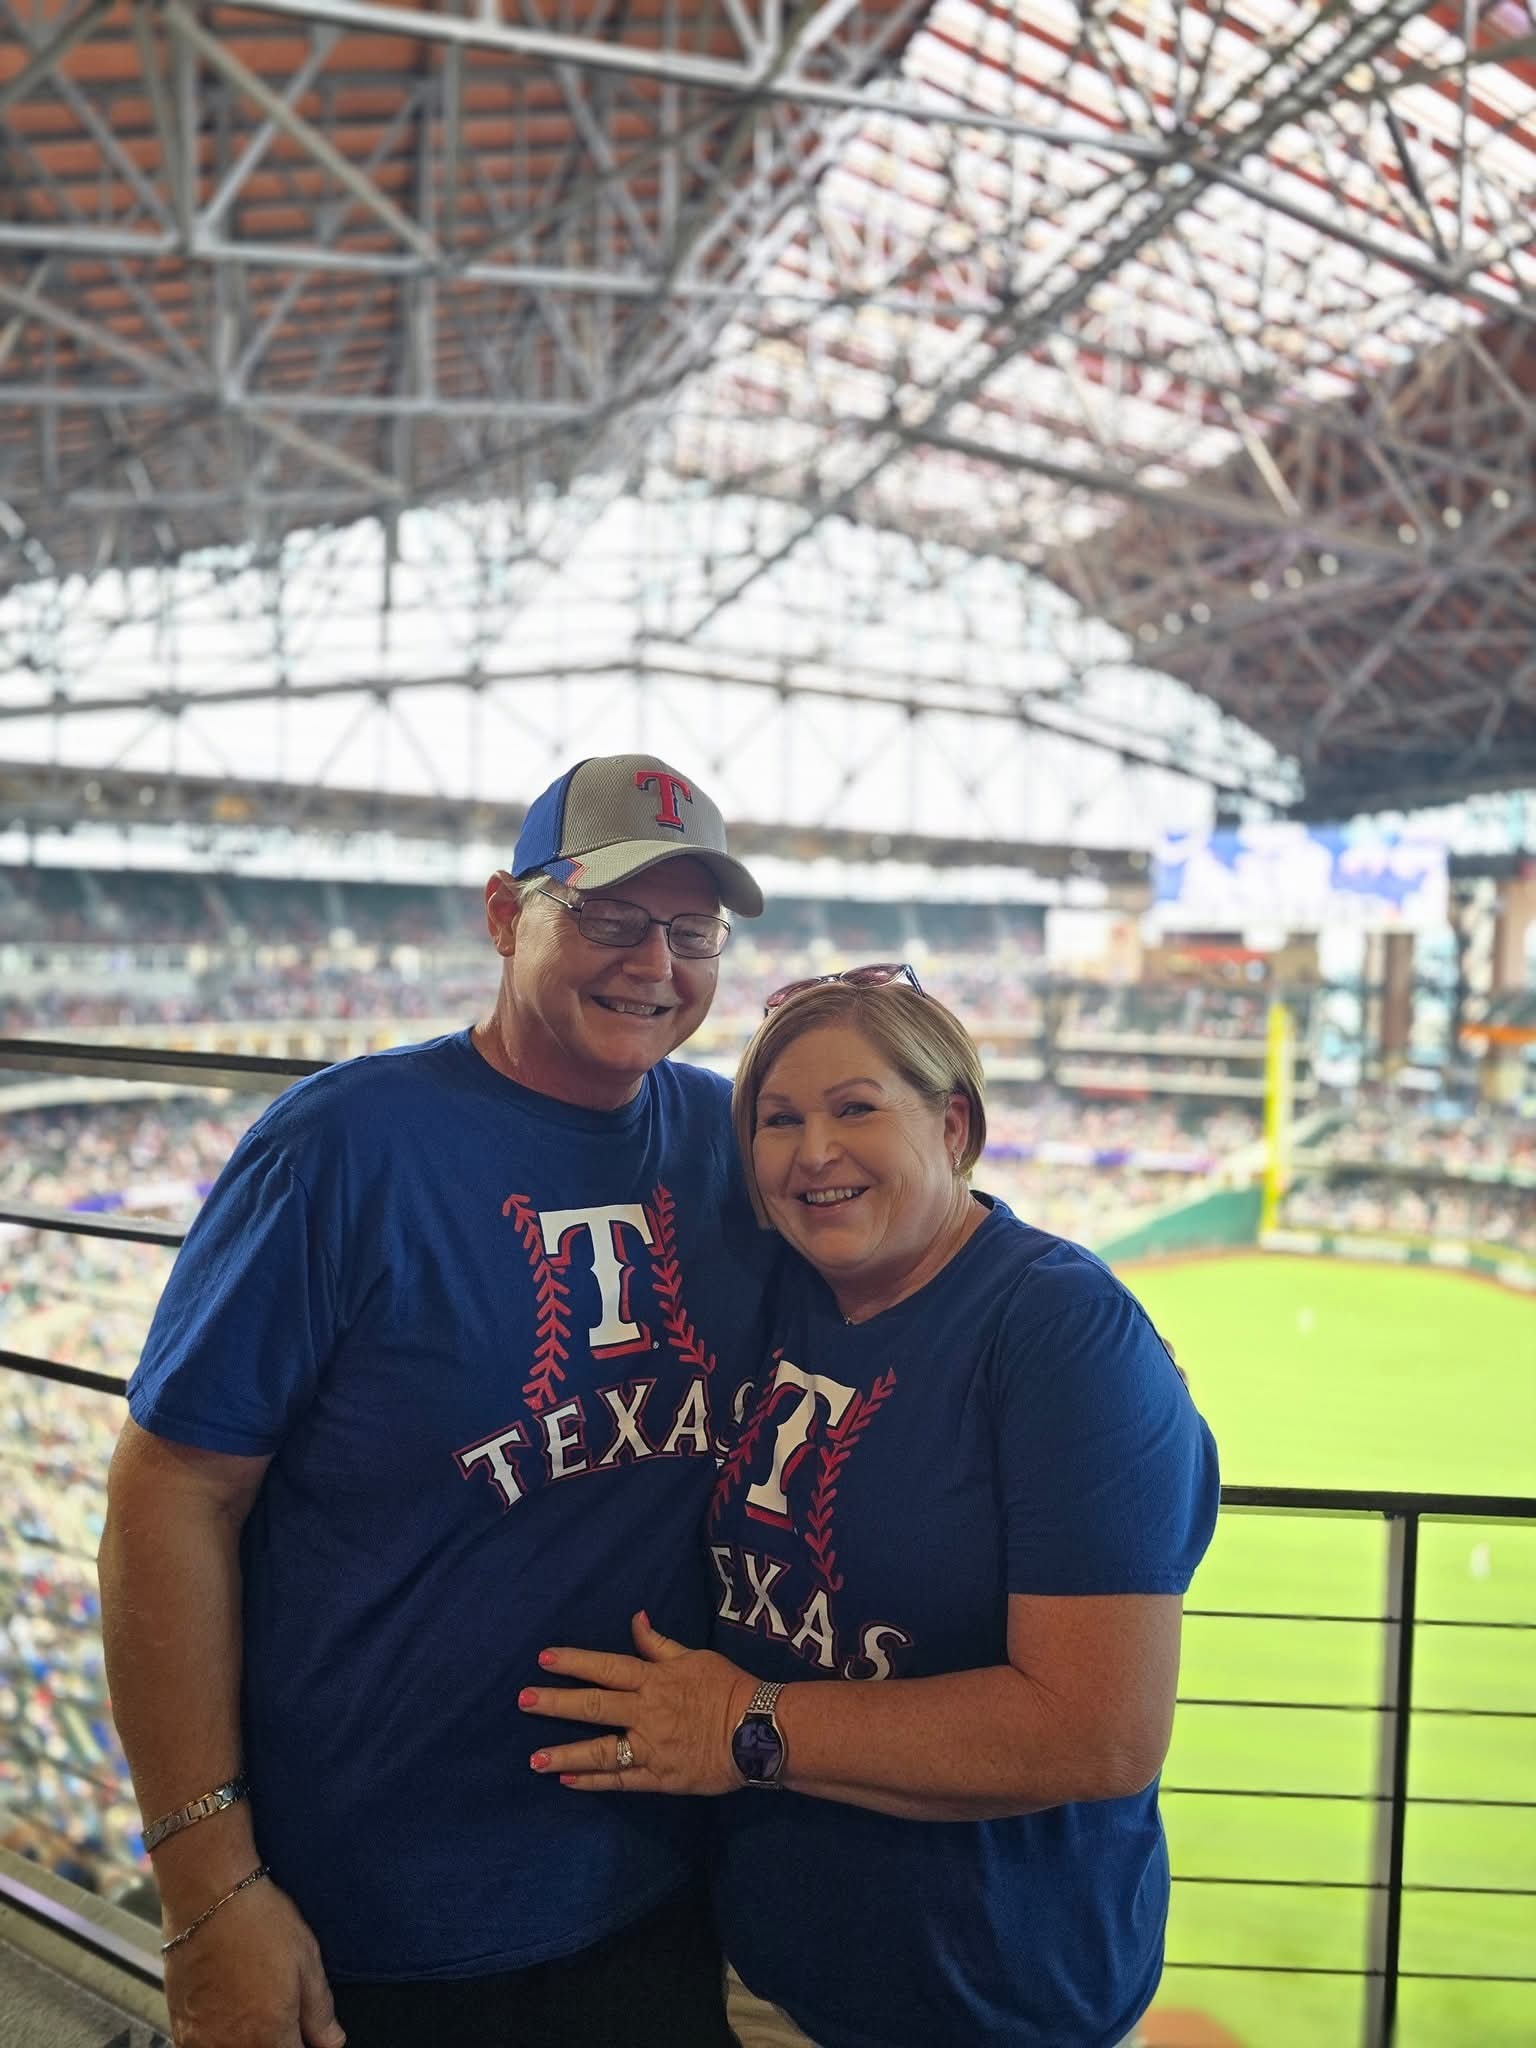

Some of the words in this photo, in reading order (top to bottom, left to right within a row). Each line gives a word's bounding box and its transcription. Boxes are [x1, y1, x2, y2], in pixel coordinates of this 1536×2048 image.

[634, 770, 692, 832] T
[538, 1203, 664, 1358] T
[746, 1360, 861, 1530] T
[710, 1546, 908, 1681] EXAS
